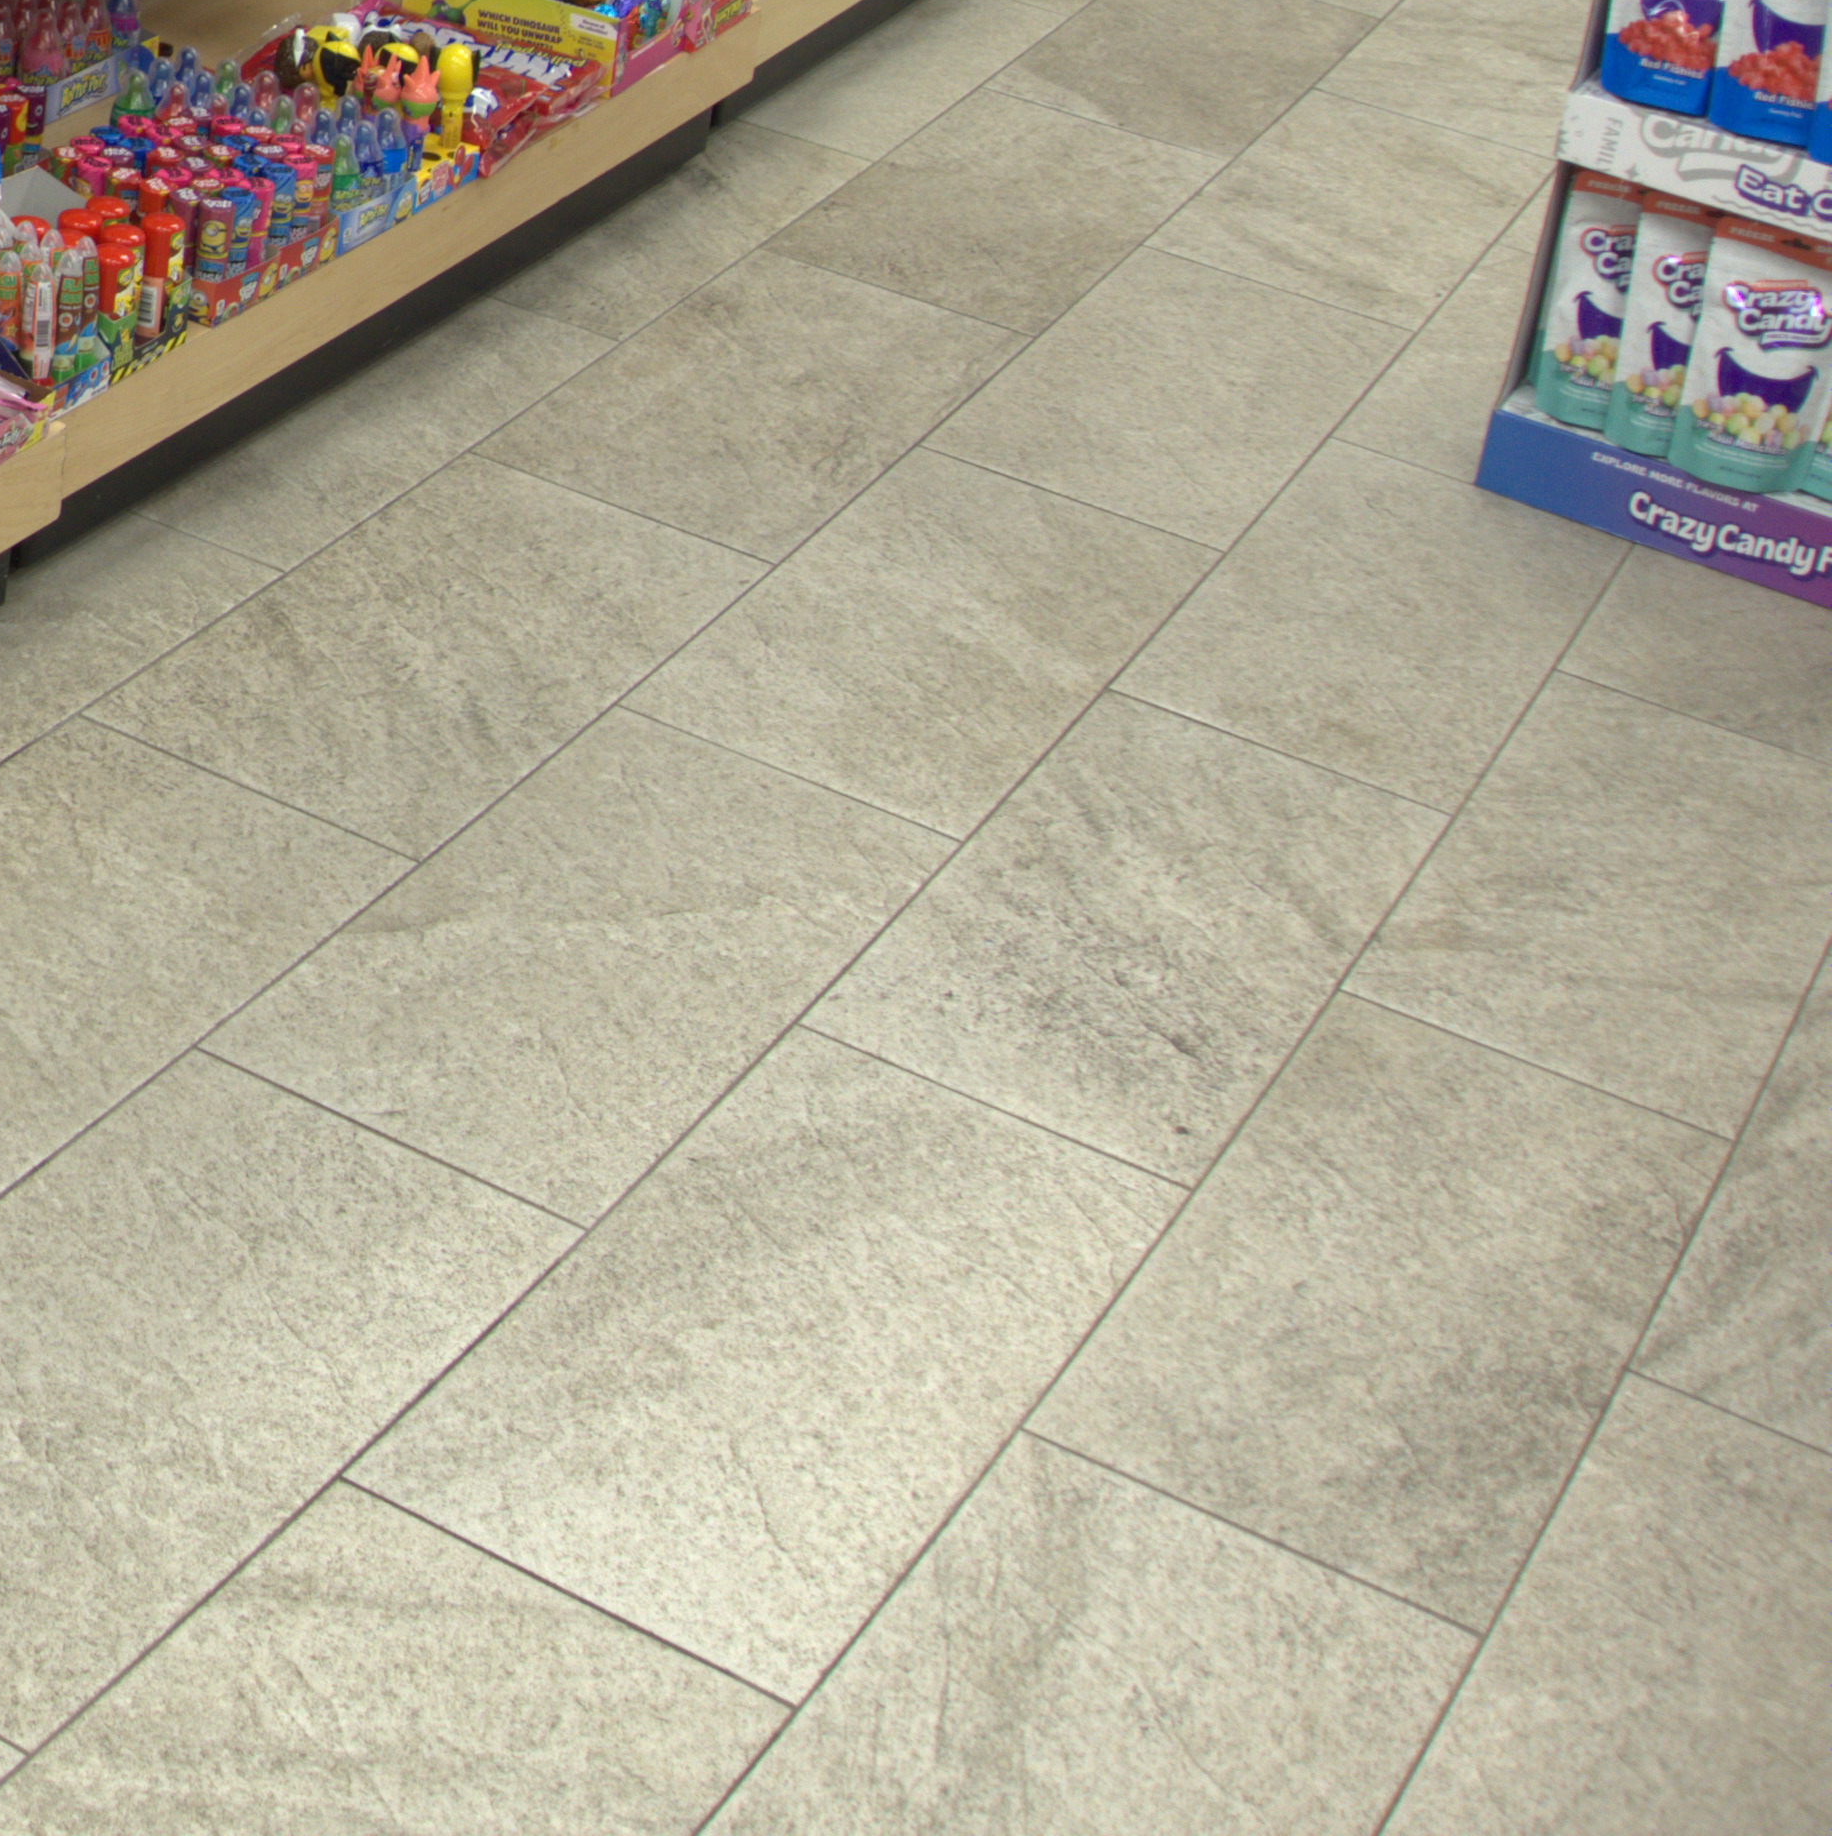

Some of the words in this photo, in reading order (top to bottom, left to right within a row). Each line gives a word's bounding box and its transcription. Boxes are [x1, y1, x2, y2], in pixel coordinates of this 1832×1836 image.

[477, 22, 497, 34] WILL
[498, 25, 516, 37] YOU
[518, 26, 563, 45] UNWRAP
[478, 10, 505, 26] WHICH
[508, 15, 562, 36] DINOSAUR
[1739, 168, 1806, 210] Eat
[1739, 308, 1831, 344] Candy
[1591, 452, 1636, 472] EXPLORE
[1640, 466, 1668, 480] MORE
[1672, 475, 1727, 498] FLAVORS
